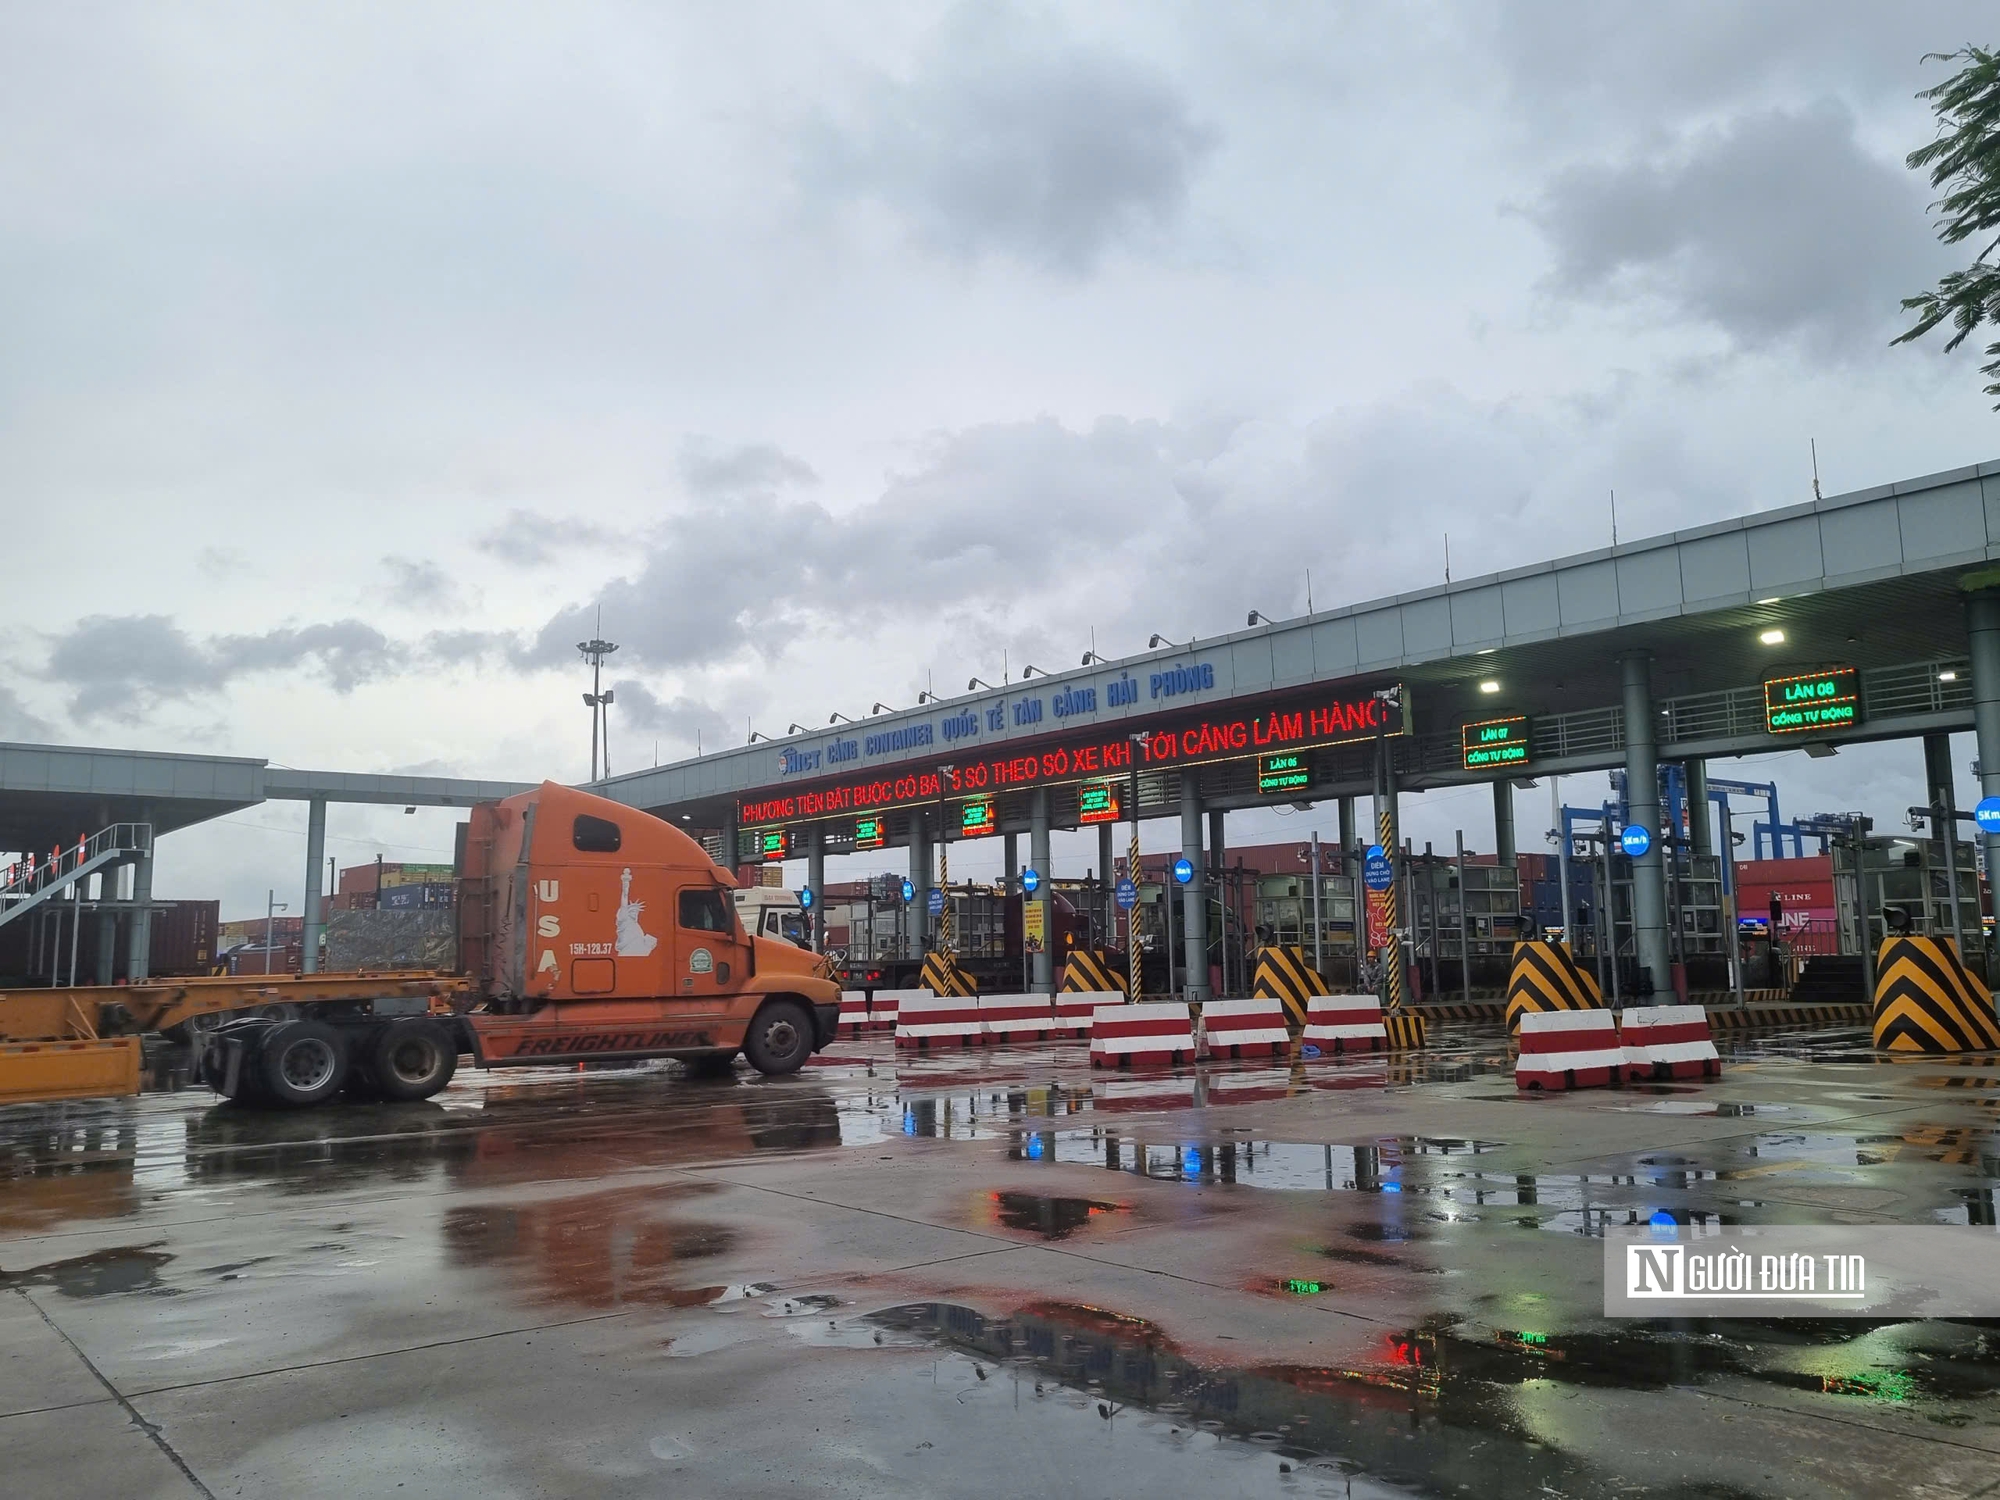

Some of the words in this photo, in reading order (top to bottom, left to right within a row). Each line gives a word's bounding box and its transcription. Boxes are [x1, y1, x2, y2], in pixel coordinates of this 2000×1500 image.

[1785, 683, 1815, 700] LÀN
[1816, 681, 1836, 696] 08
[827, 737, 858, 764] CẢNG
[865, 723, 934, 756] CONTAINER
[942, 708, 978, 742] QUỐC
[986, 700, 1005, 731] TẾ
[1012, 697, 1043, 726] TÂN
[1052, 685, 1098, 718] CẢNG
[1107, 670, 1139, 707] HẢI
[1150, 663, 1214, 699] PHÒNG
[1481, 728, 1498, 742] LÀN
[1498, 727, 1508, 739] 07
[743, 797, 795, 823] PHƯƠNG
[796, 792, 824, 815] TIỆN
[853, 781, 892, 806] BUỘC
[991, 756, 1039, 785] THEO
[1072, 746, 1099, 773] XE
[1103, 741, 1131, 768] KH
[1253, 711, 1303, 745] LÀM
[1269, 757, 1287, 770] LÀN
[1978, 811, 2000, 821] 5Km
[1623, 834, 1647, 846] 5Km/h
[1784, 893, 1812, 901] LINE
[515, 1031, 714, 1055] FREIGHTLINER
